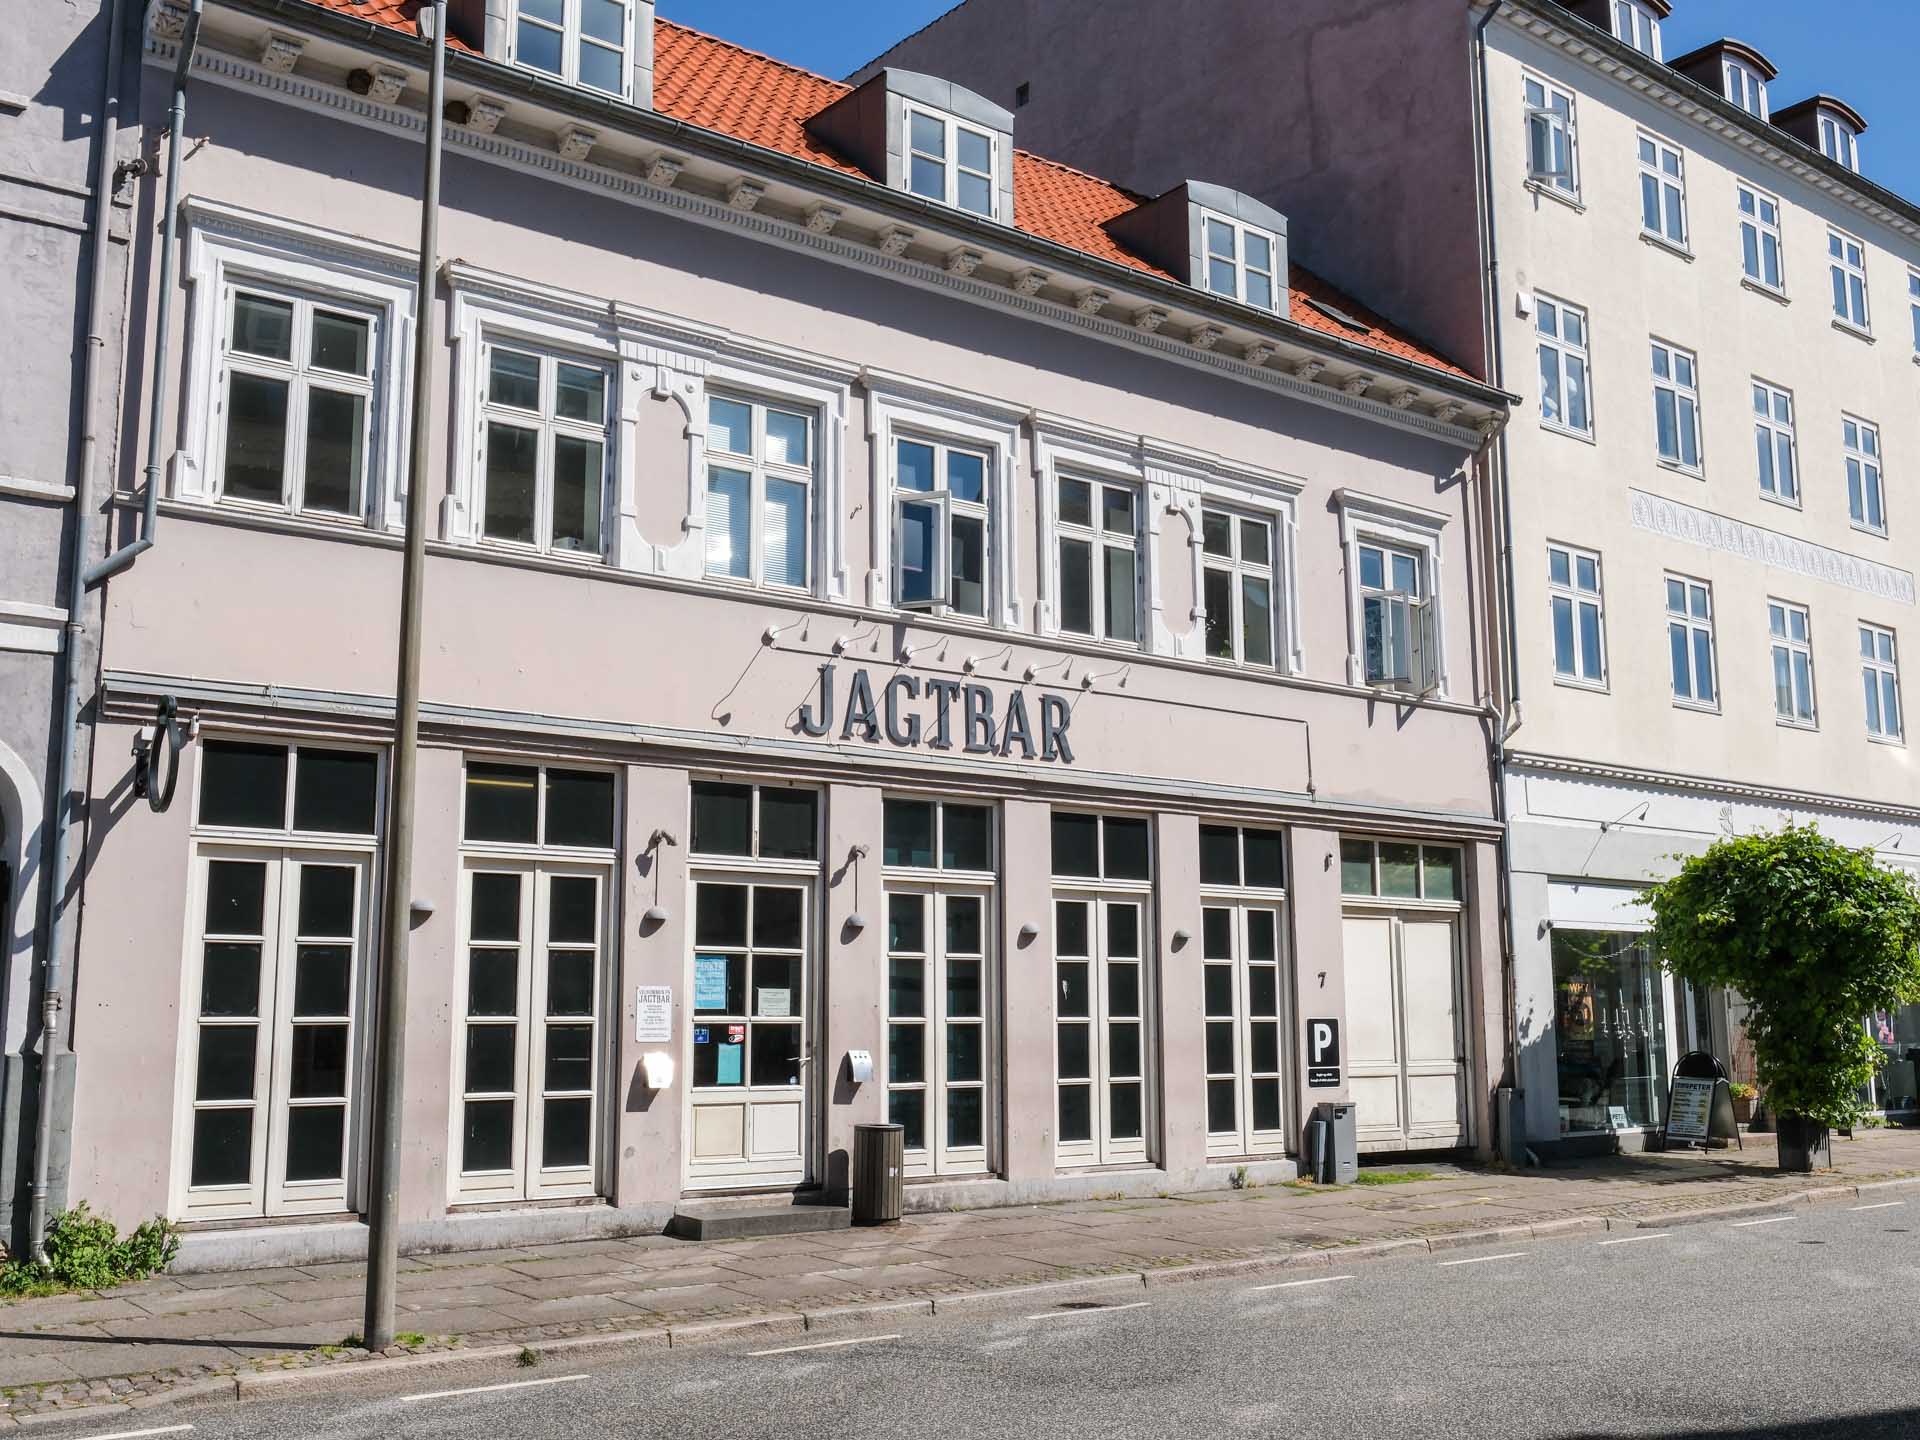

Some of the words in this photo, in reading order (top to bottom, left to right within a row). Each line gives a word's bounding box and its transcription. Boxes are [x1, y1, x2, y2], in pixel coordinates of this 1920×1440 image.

[800, 664, 1075, 764] JAGTBAR
[1317, 971, 1327, 989] 7
[638, 994, 671, 1004] JAGTBAR
[1314, 1023, 1332, 1063] P
